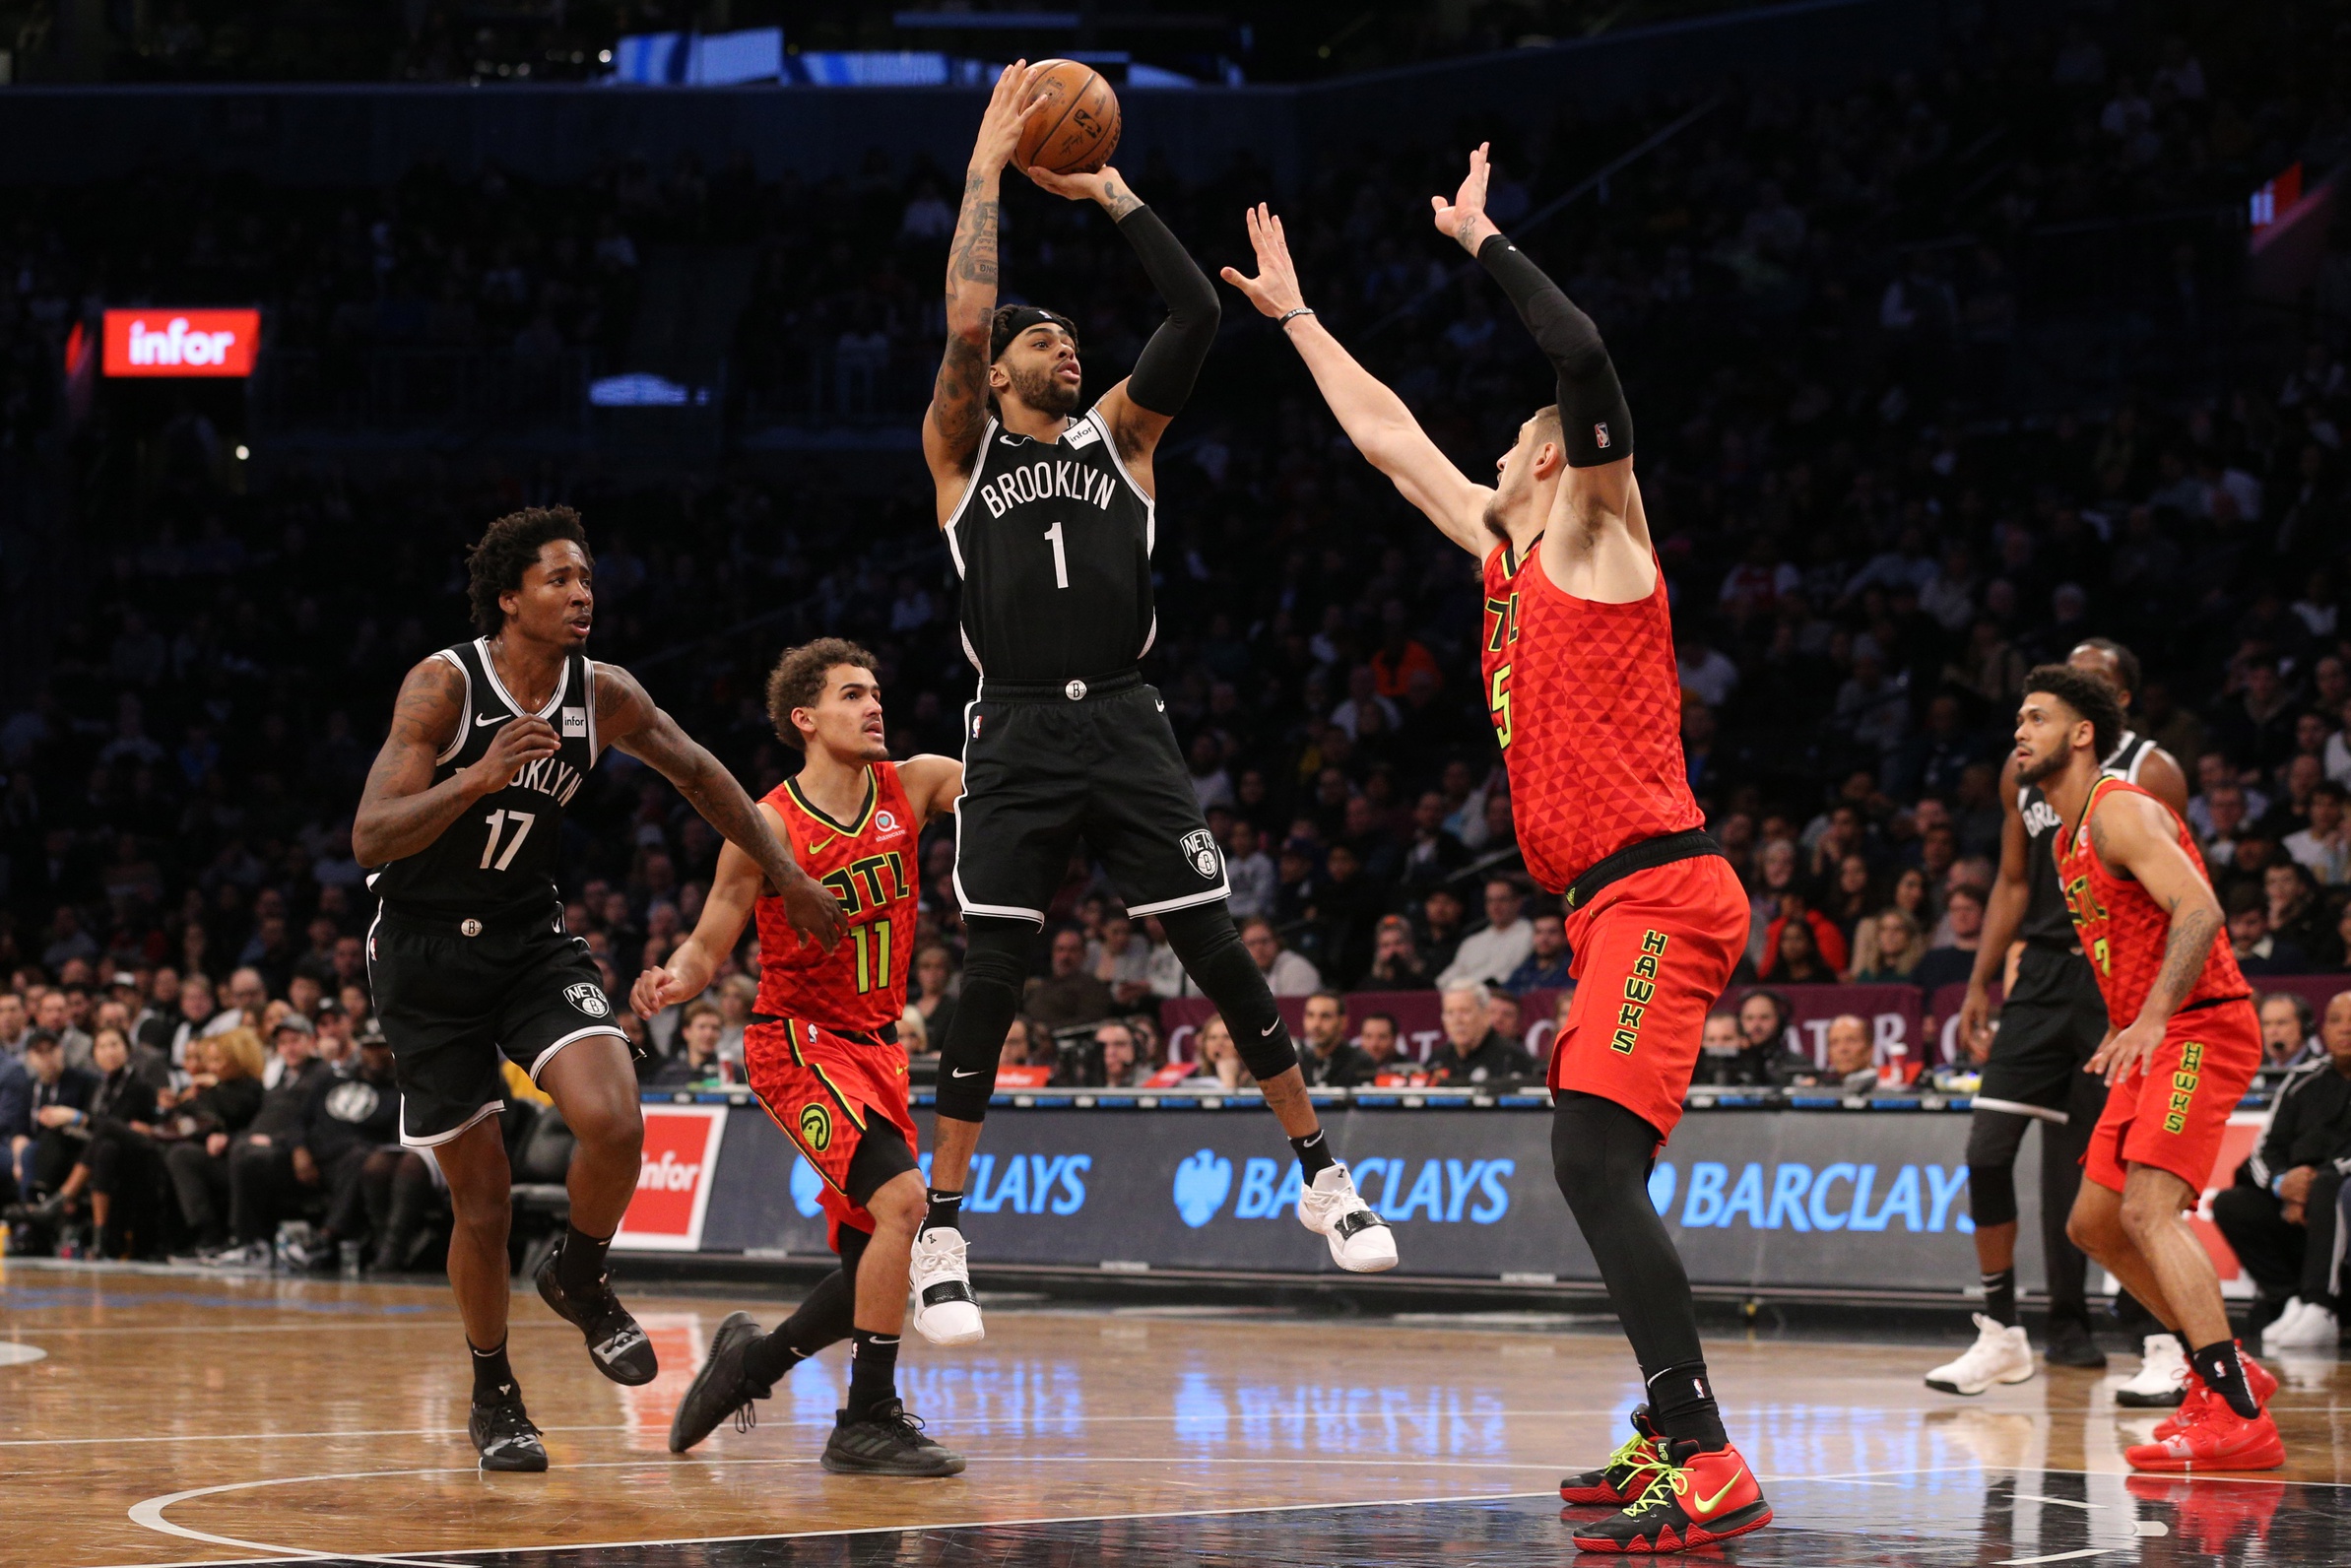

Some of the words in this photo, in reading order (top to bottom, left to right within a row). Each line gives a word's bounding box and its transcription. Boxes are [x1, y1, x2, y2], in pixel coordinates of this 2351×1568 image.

[129, 317, 234, 365] infor
[1069, 426, 1092, 443] infor
[980, 460, 1116, 519] BROOKLYN
[1044, 521, 1069, 589] 1
[1484, 591, 1520, 652] TL
[564, 716, 584, 726] infor
[1491, 663, 1512, 750] 5
[479, 808, 536, 872] 17
[1183, 831, 1215, 857] NETS
[819, 851, 910, 917] ATL
[849, 918, 890, 996] 11
[1610, 928, 1669, 1056] HAWKS
[2162, 1041, 2205, 1136] HAWKS
[1234, 1156, 1515, 1225] BACLAYS
